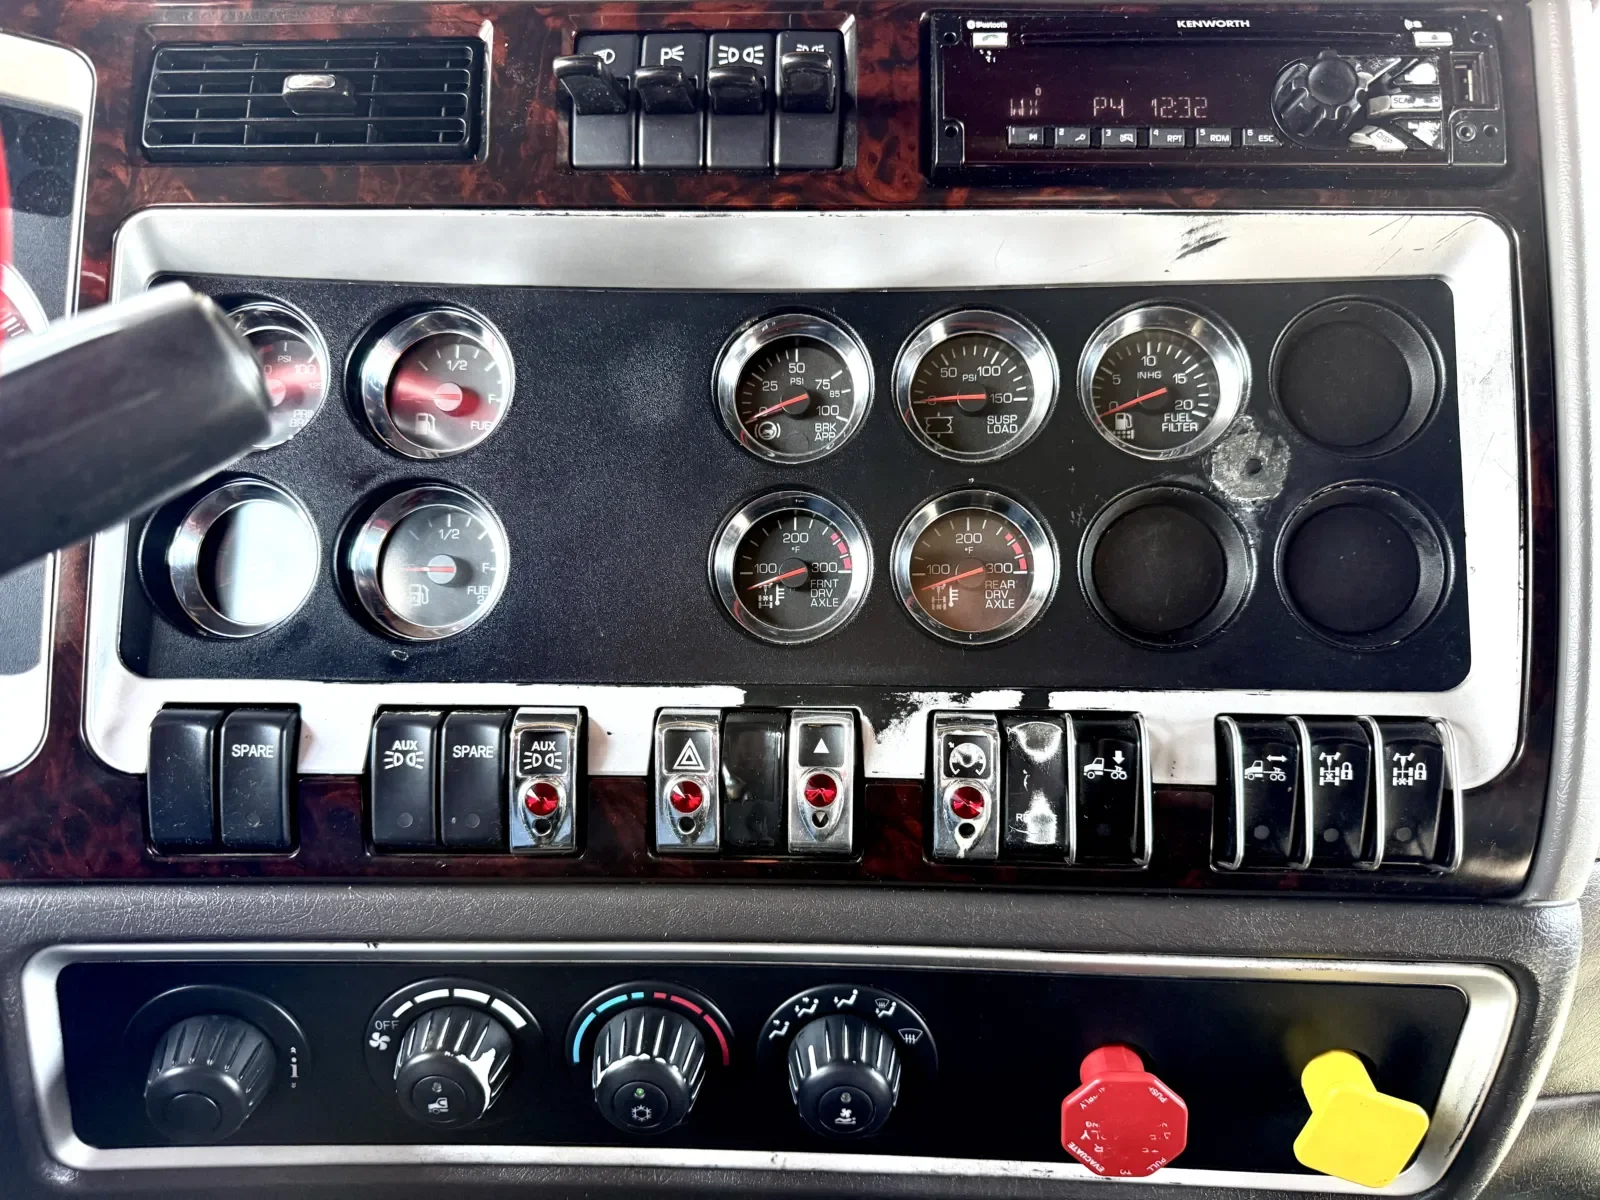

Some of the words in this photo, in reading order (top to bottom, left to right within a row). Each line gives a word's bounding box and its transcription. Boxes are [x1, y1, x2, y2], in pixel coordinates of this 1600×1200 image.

[975, 21, 1008, 29] Bluetooth
[1176, 20, 1251, 28] KENWORTH
[1093, 97, 1124, 117] P4
[1151, 97, 1208, 118] 12:32
[1059, 128, 1065, 136] 2
[1105, 129, 1112, 137] 3
[1376, 131, 1393, 144] DISP
[1167, 135, 1183, 143] RPT
[1210, 134, 1230, 142] RDM
[1258, 134, 1274, 142] ESC
[446, 360, 469, 372] 1/2
[1141, 355, 1157, 367] 10
[294, 364, 316, 375] 100
[788, 362, 806, 374] 50
[940, 367, 958, 378] 50
[977, 365, 1001, 377] 100
[790, 378, 804, 386] PSI
[962, 374, 977, 382] PSI
[1112, 375, 1121, 385] 5
[1173, 373, 1187, 384] 15
[762, 381, 778, 392] 25
[815, 379, 831, 390] 75
[488, 394, 496, 404] F
[829, 390, 841, 398] 85
[990, 393, 1013, 404] 150
[816, 405, 840, 416] 100
[1174, 400, 1193, 411] 20
[987, 415, 1018, 425] SUSP
[1164, 413, 1193, 423] FUEL
[814, 423, 837, 432] BRK
[987, 425, 1018, 434] LOAD
[1161, 423, 1199, 432] FILTER
[814, 432, 836, 441] APP
[438, 528, 460, 541] 1/2
[782, 532, 809, 544] 200
[955, 532, 983, 544] 200
[482, 562, 490, 573] F
[754, 563, 777, 574] 100
[811, 562, 838, 573] 300
[926, 564, 951, 575] 100
[986, 563, 1013, 574] 300
[810, 579, 839, 588] FRNT
[985, 580, 1016, 589] REAR
[810, 589, 834, 598] DRV
[985, 590, 1009, 599] DRV
[810, 598, 839, 608] AXLE
[985, 599, 1015, 609] AXLE
[392, 740, 418, 751] AUX
[531, 741, 557, 751] AUX
[231, 744, 275, 759] SPARE
[452, 745, 494, 759] SPARE
[375, 1020, 400, 1030] OFF
[1067, 1141, 1106, 1173] EVACUATE
[1146, 1157, 1167, 1172] PULL
